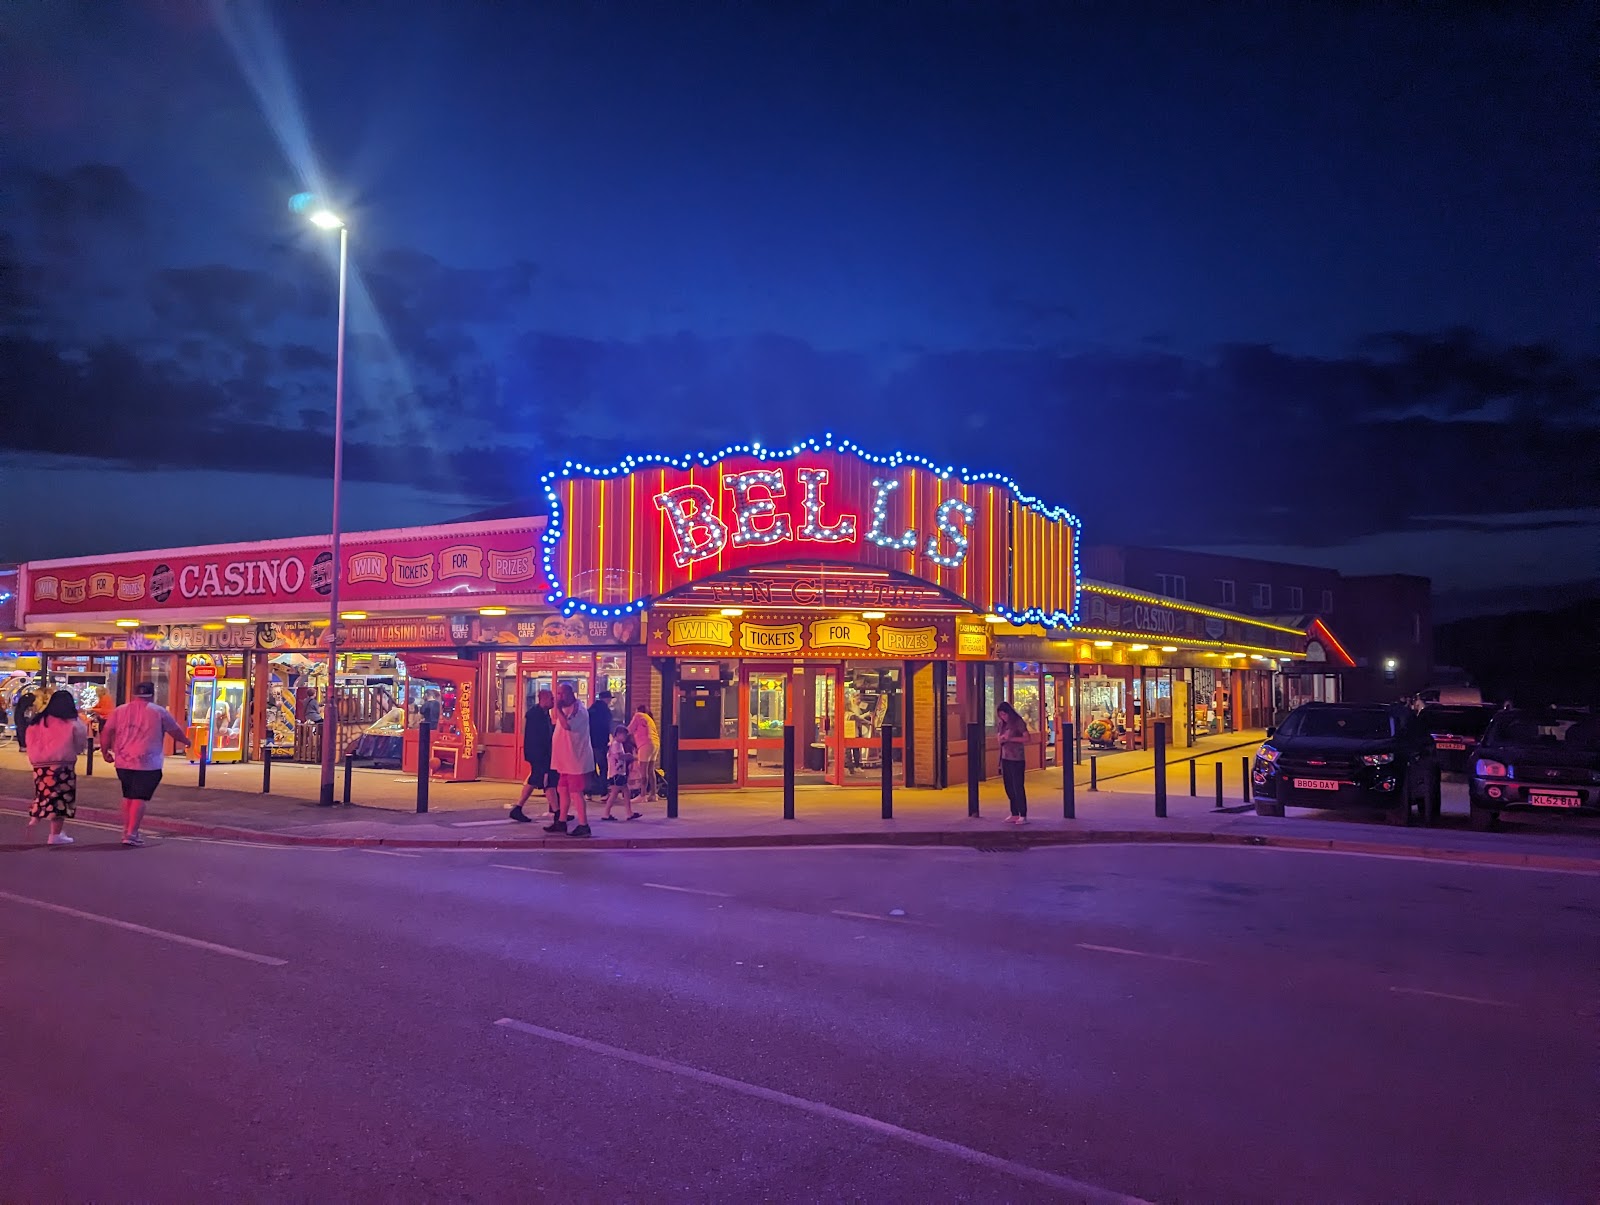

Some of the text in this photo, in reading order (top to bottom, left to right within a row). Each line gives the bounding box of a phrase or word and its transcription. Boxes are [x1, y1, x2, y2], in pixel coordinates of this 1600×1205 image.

[653, 467, 977, 568] BELLS
[178, 556, 306, 599] CASINO
[354, 553, 529, 580] WIN TICKETS FOR PRIZES
[64, 585, 83, 598] TICKETS
[96, 578, 107, 590] FOR
[121, 581, 141, 595] PRIZES
[451, 624, 469, 632] BELLS
[517, 622, 536, 631] BELLS
[589, 621, 608, 630] BELLS
[1134, 604, 1176, 634] CASINO
[169, 625, 257, 649] ORBITORS
[351, 624, 379, 643] ADULT
[381, 622, 418, 643] CASINO
[419, 621, 446, 642] AREA
[677, 620, 930, 649] WIN TICKETS FOR PRIZES
[1319, 781, 1335, 789] DAY
